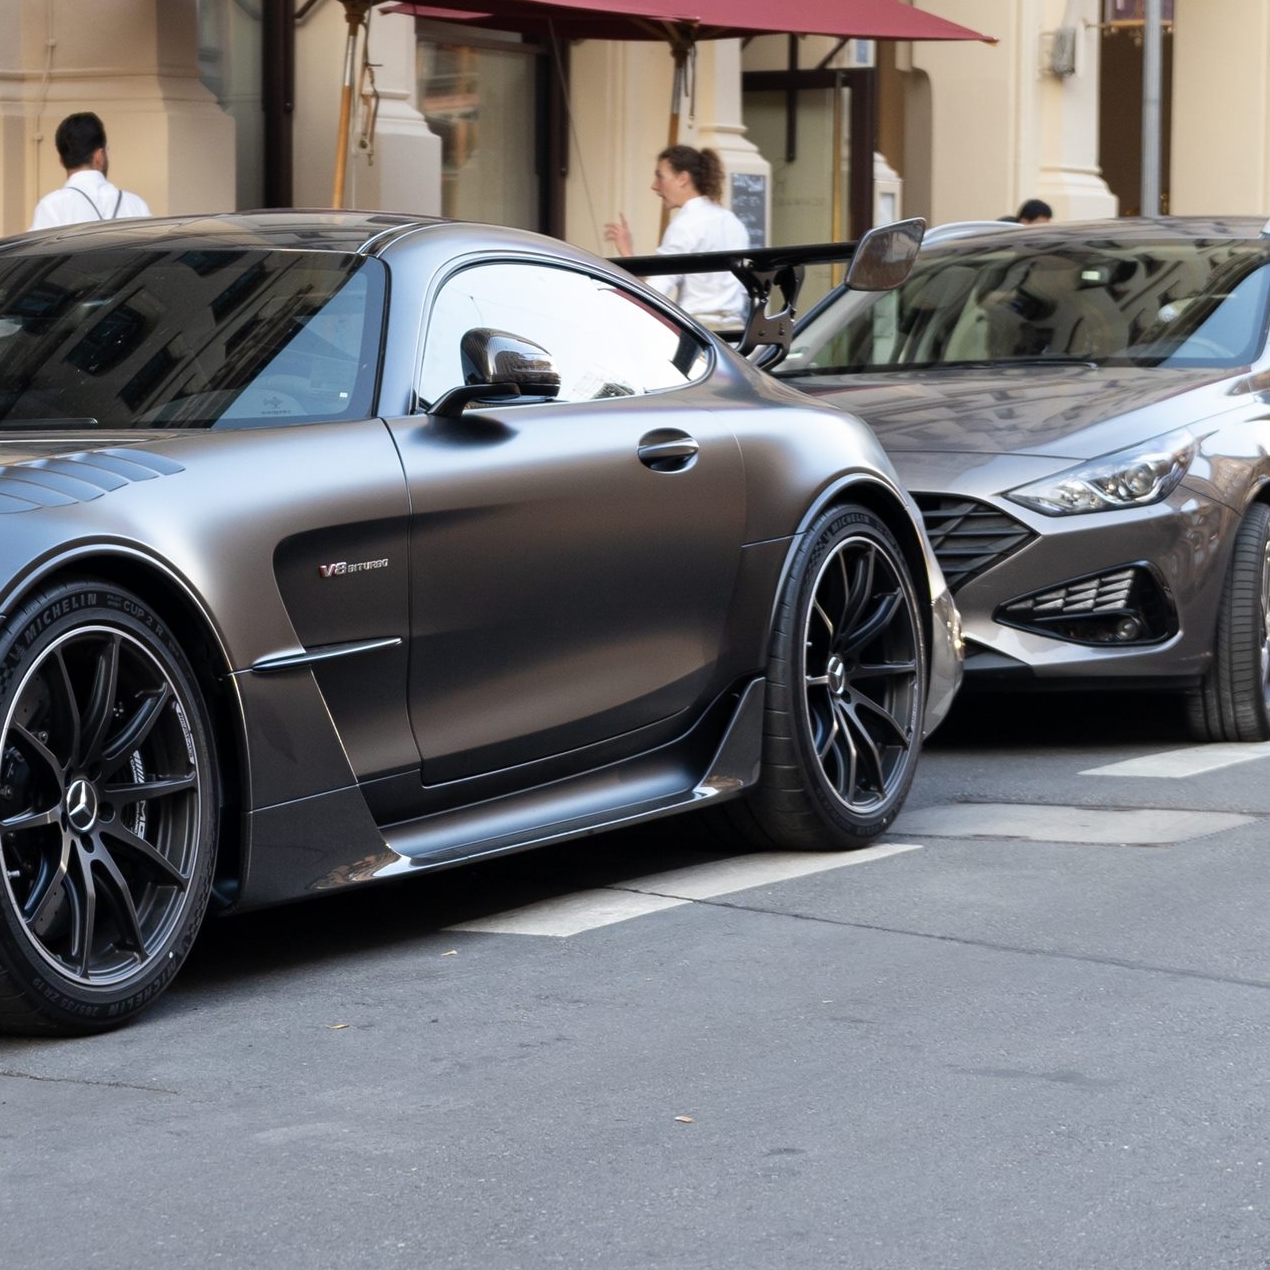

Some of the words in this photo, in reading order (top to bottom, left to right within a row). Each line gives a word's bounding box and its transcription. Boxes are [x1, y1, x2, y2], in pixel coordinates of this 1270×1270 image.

[318, 561, 347, 577] V8
[347, 558, 388, 573] BITURBO
[24, 593, 97, 646] MICHELIN
[123, 600, 145, 618] CUP
[146, 616, 153, 626] 2
